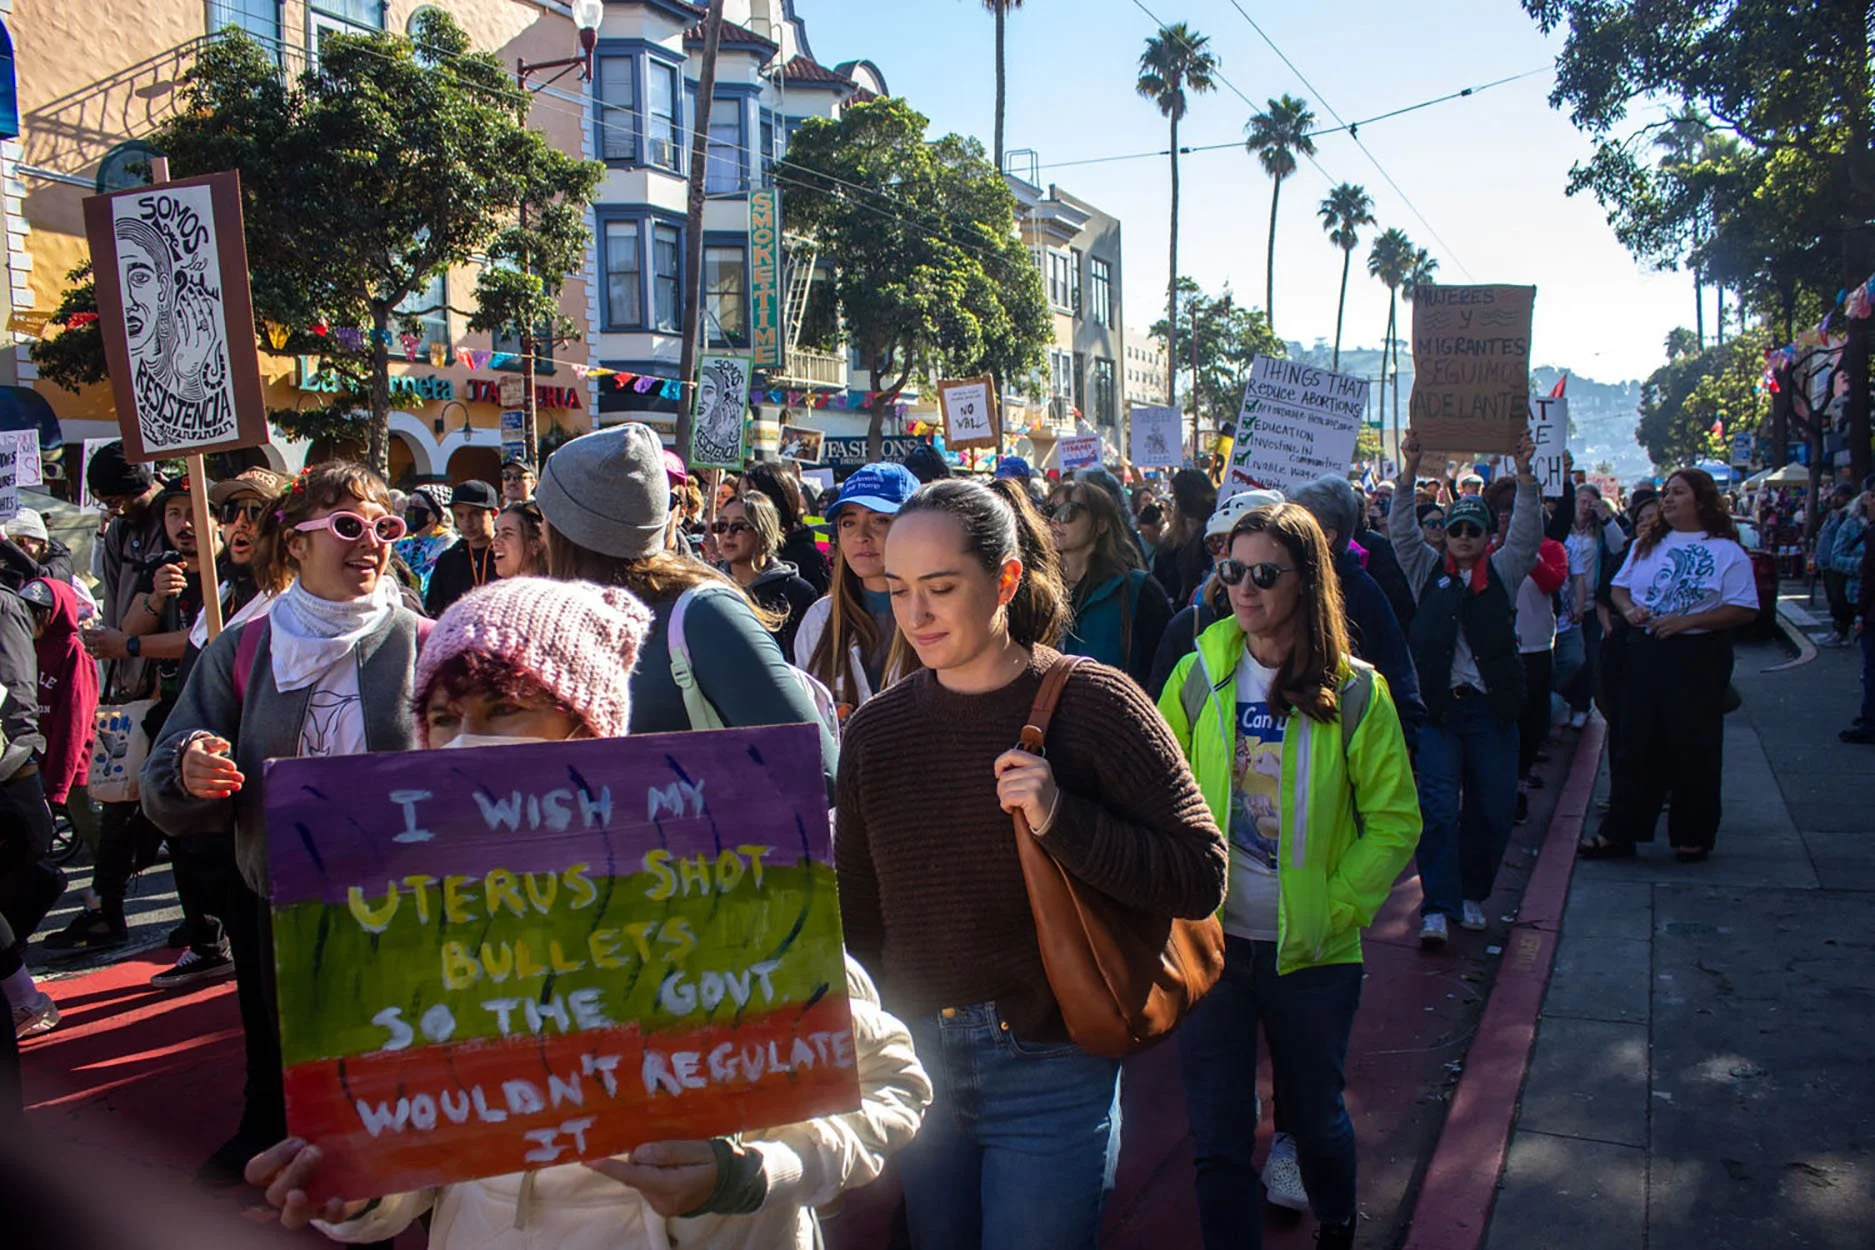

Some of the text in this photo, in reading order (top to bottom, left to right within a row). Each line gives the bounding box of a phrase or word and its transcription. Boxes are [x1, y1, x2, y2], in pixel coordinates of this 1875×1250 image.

[138, 196, 209, 254] SOMOS
[1414, 287, 1494, 308] MUJERES
[1417, 337, 1527, 356] MIGRANTES
[136, 357, 232, 430] RESISTENCIA
[1260, 356, 1369, 399] THINGS THAT
[1420, 359, 1529, 388] SEGUIMOS
[1413, 389, 1529, 421] ADELANTE
[1254, 421, 1314, 443] EDUCATION
[1242, 706, 1273, 729] Can
[390, 777, 706, 843] I WISH MY
[347, 844, 776, 935] UTERUS SHOT
[441, 916, 699, 991] BULLETS
[371, 1004, 457, 1052] SO
[481, 987, 613, 1035] THE
[641, 1028, 852, 1099] REGULATE
[522, 1117, 595, 1163] IT
